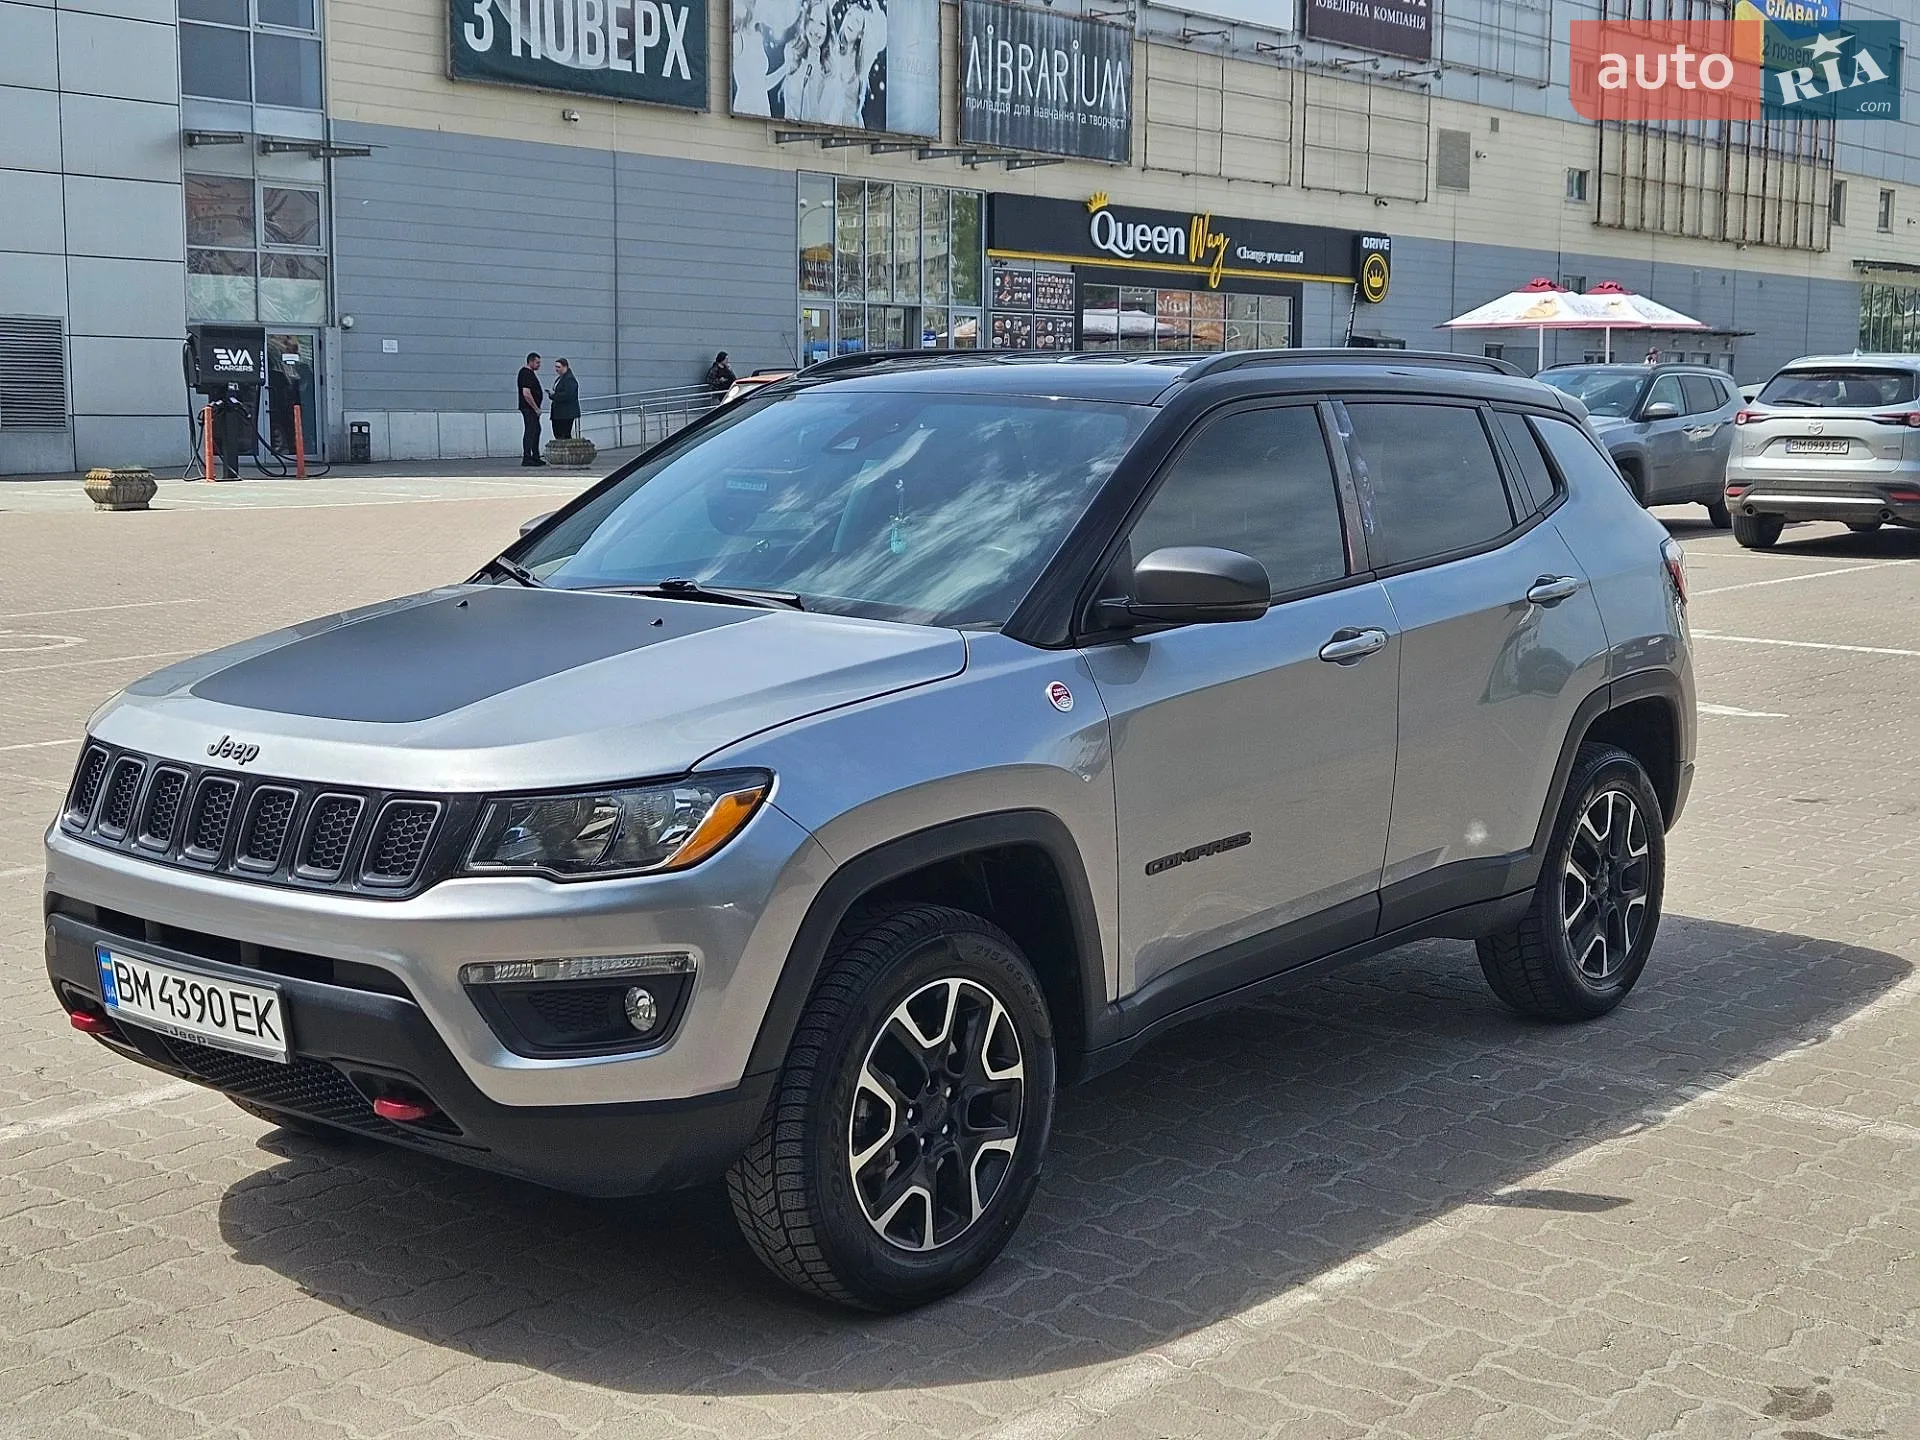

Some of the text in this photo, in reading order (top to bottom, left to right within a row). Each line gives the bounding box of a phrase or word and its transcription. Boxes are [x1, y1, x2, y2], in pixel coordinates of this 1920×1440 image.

[463, 0, 495, 52] 3
[1373, 6, 1427, 31] КОМПАНІЯ
[965, 96, 1127, 130] приладдя для навчання та творчості
[1090, 208, 1304, 289] Queen Way Change your mind
[1362, 236, 1390, 251] DRIVE
[213, 348, 254, 365] EVA
[213, 364, 254, 372] CHARGERS
[1792, 440, 1806, 451] BM
[207, 734, 260, 766] Jeep
[105, 983, 117, 999] UA
[113, 960, 282, 1042] BM 4390 EK
[170, 1027, 207, 1045] Jeep
